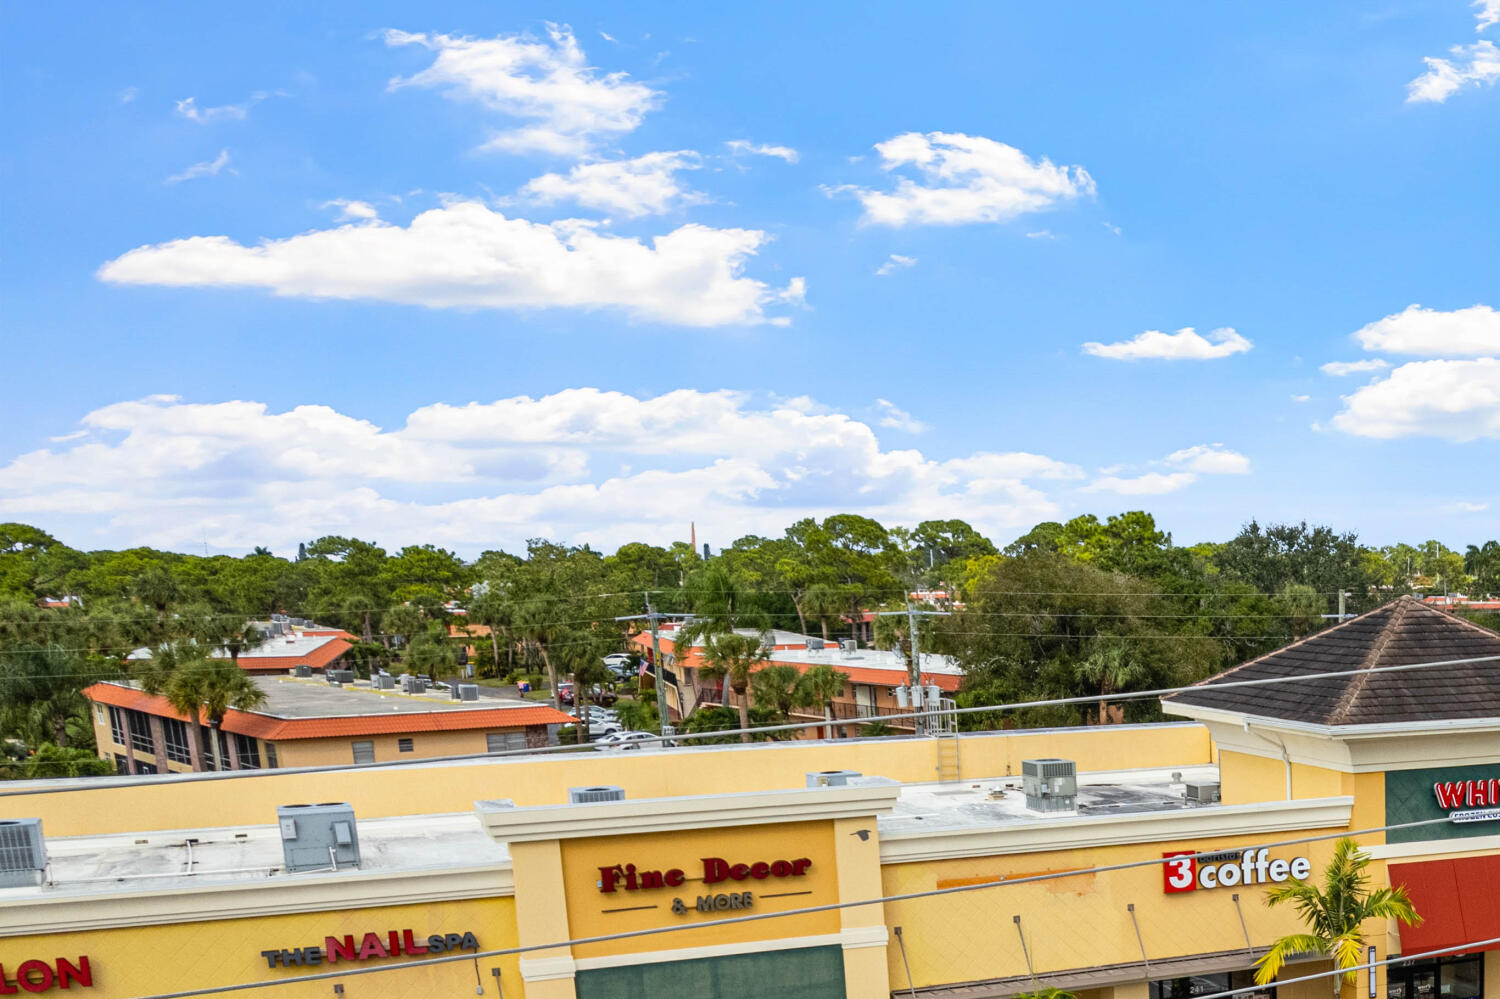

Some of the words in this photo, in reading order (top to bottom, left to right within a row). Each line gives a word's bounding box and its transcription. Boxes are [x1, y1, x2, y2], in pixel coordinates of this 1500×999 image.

[598, 863, 685, 893] Fine
[701, 857, 812, 884] Decor
[1169, 855, 1193, 889] 3
[1199, 848, 1310, 888] coffee
[672, 898, 687, 915] &
[697, 892, 753, 913] MORE
[261, 946, 322, 968] THE
[325, 929, 428, 963] NAIL
[428, 931, 480, 953] SPA
[1190, 986, 1204, 994] 241
